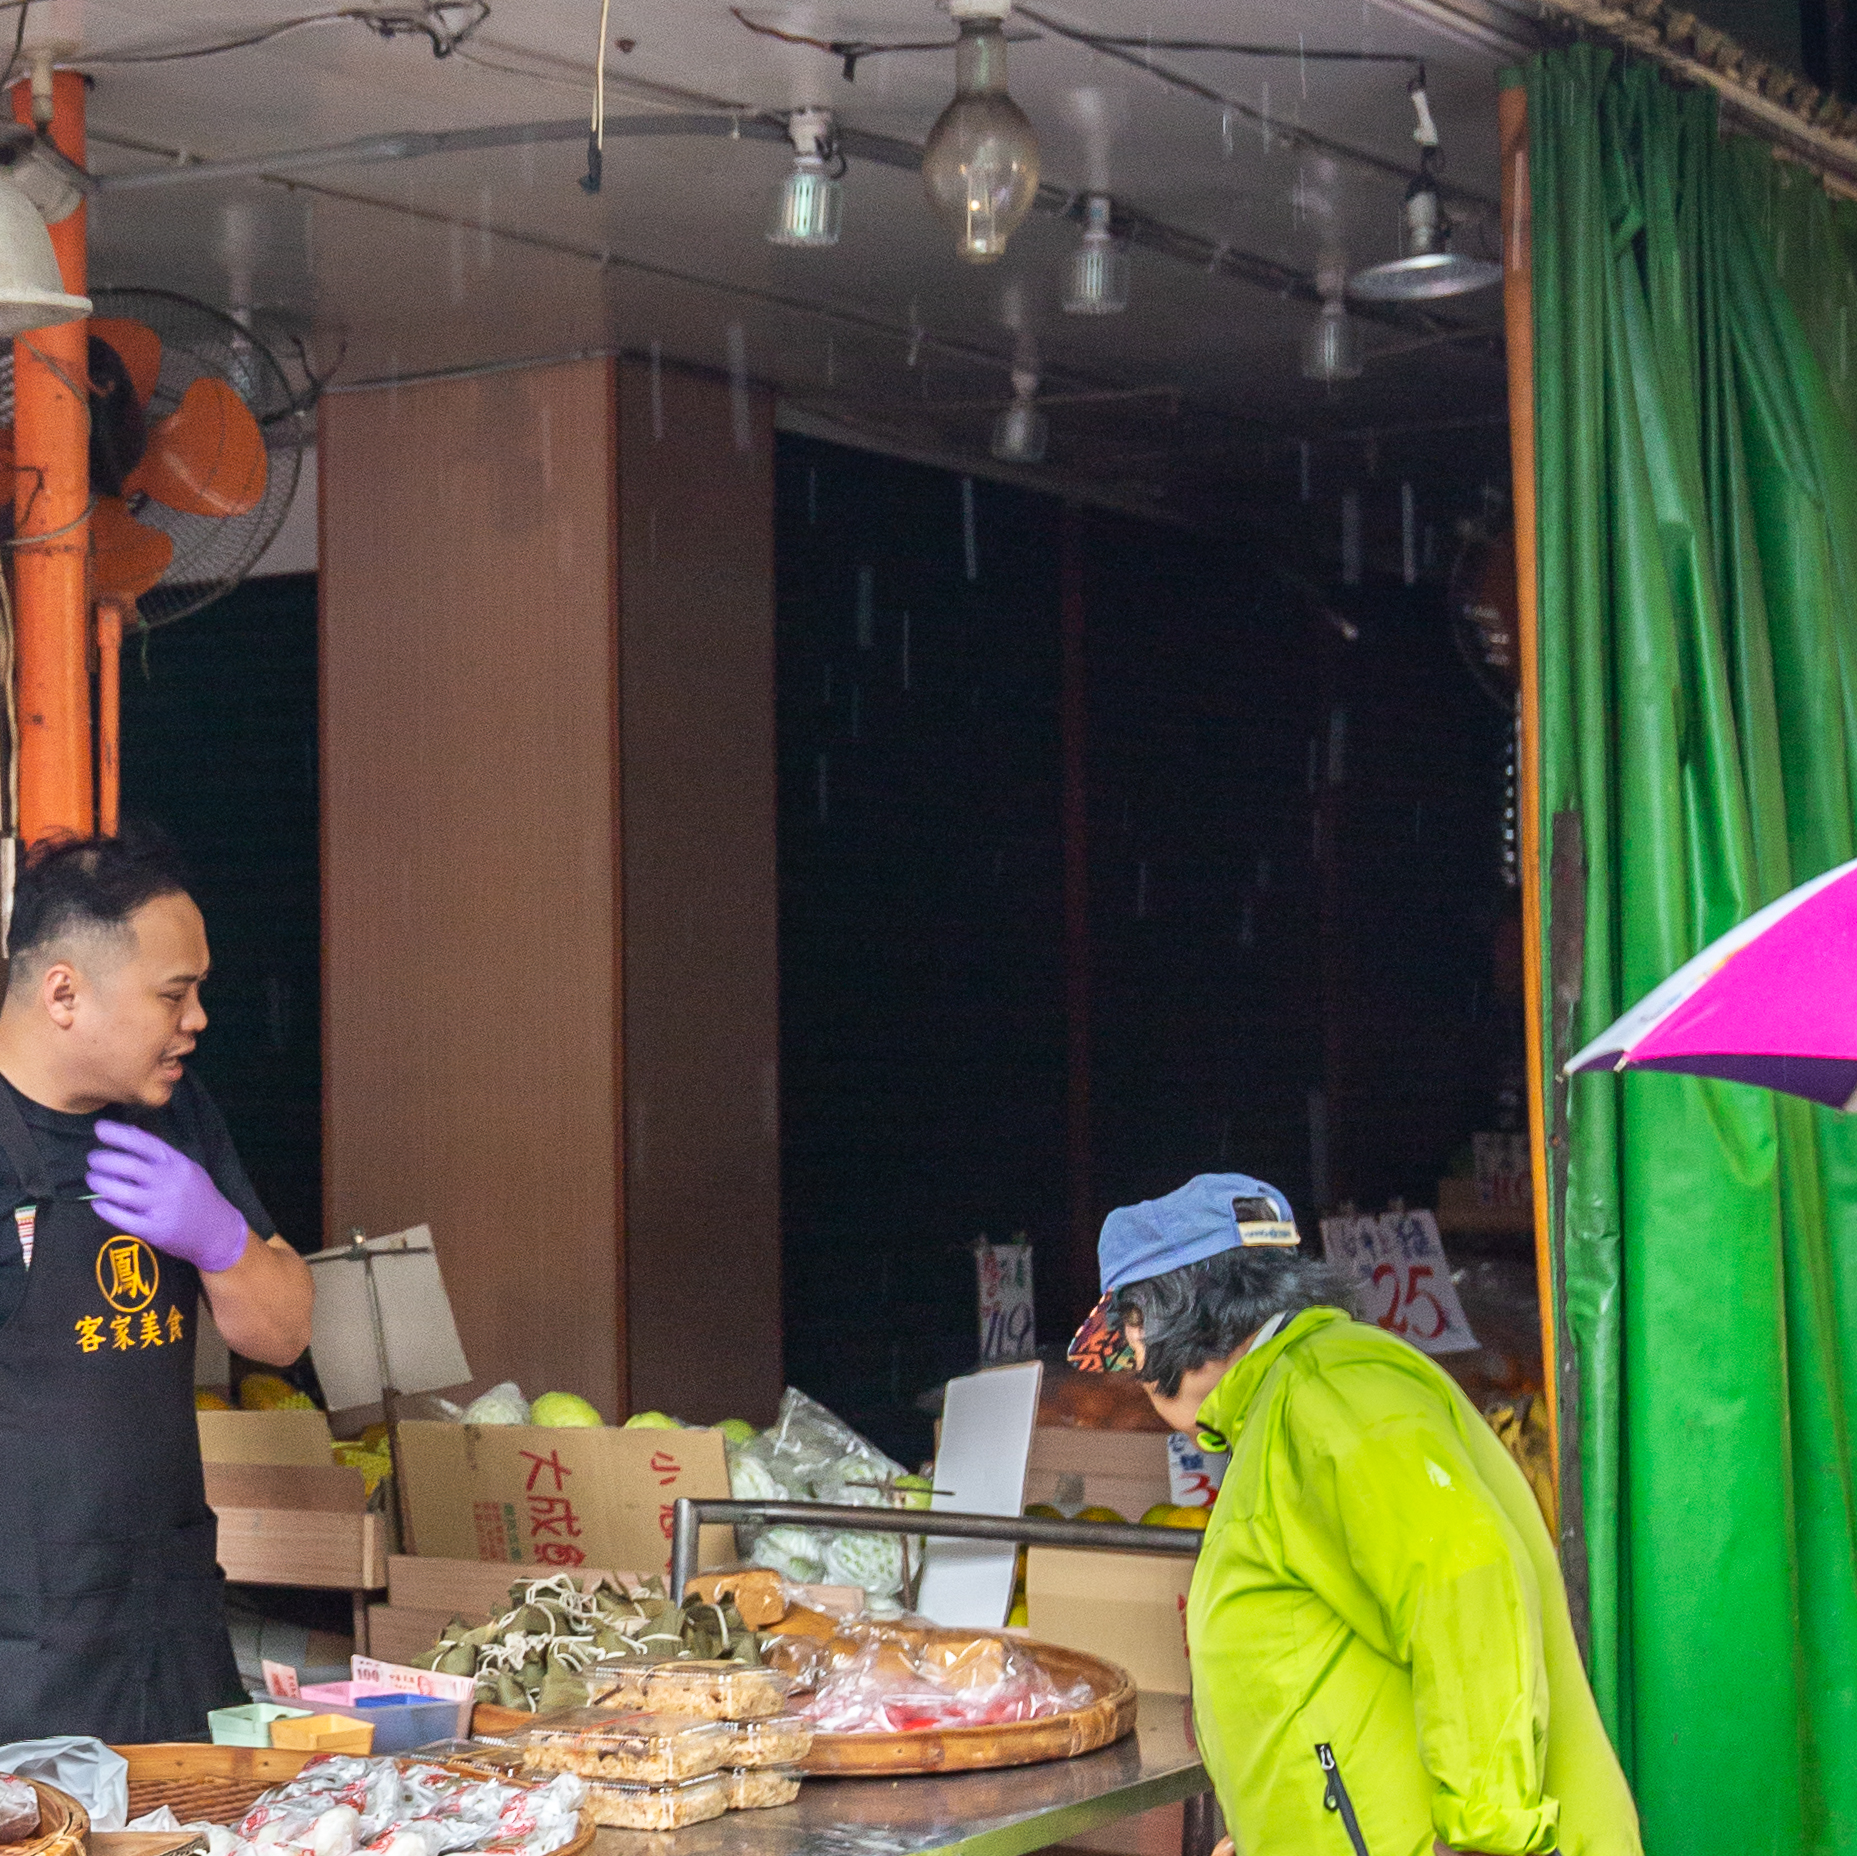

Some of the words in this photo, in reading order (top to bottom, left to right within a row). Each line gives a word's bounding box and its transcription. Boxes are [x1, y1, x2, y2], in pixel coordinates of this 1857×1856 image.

[108, 1243, 151, 1299] 鳳
[74, 1304, 184, 1353] 客家美食
[1373, 1262, 1446, 1339] 25
